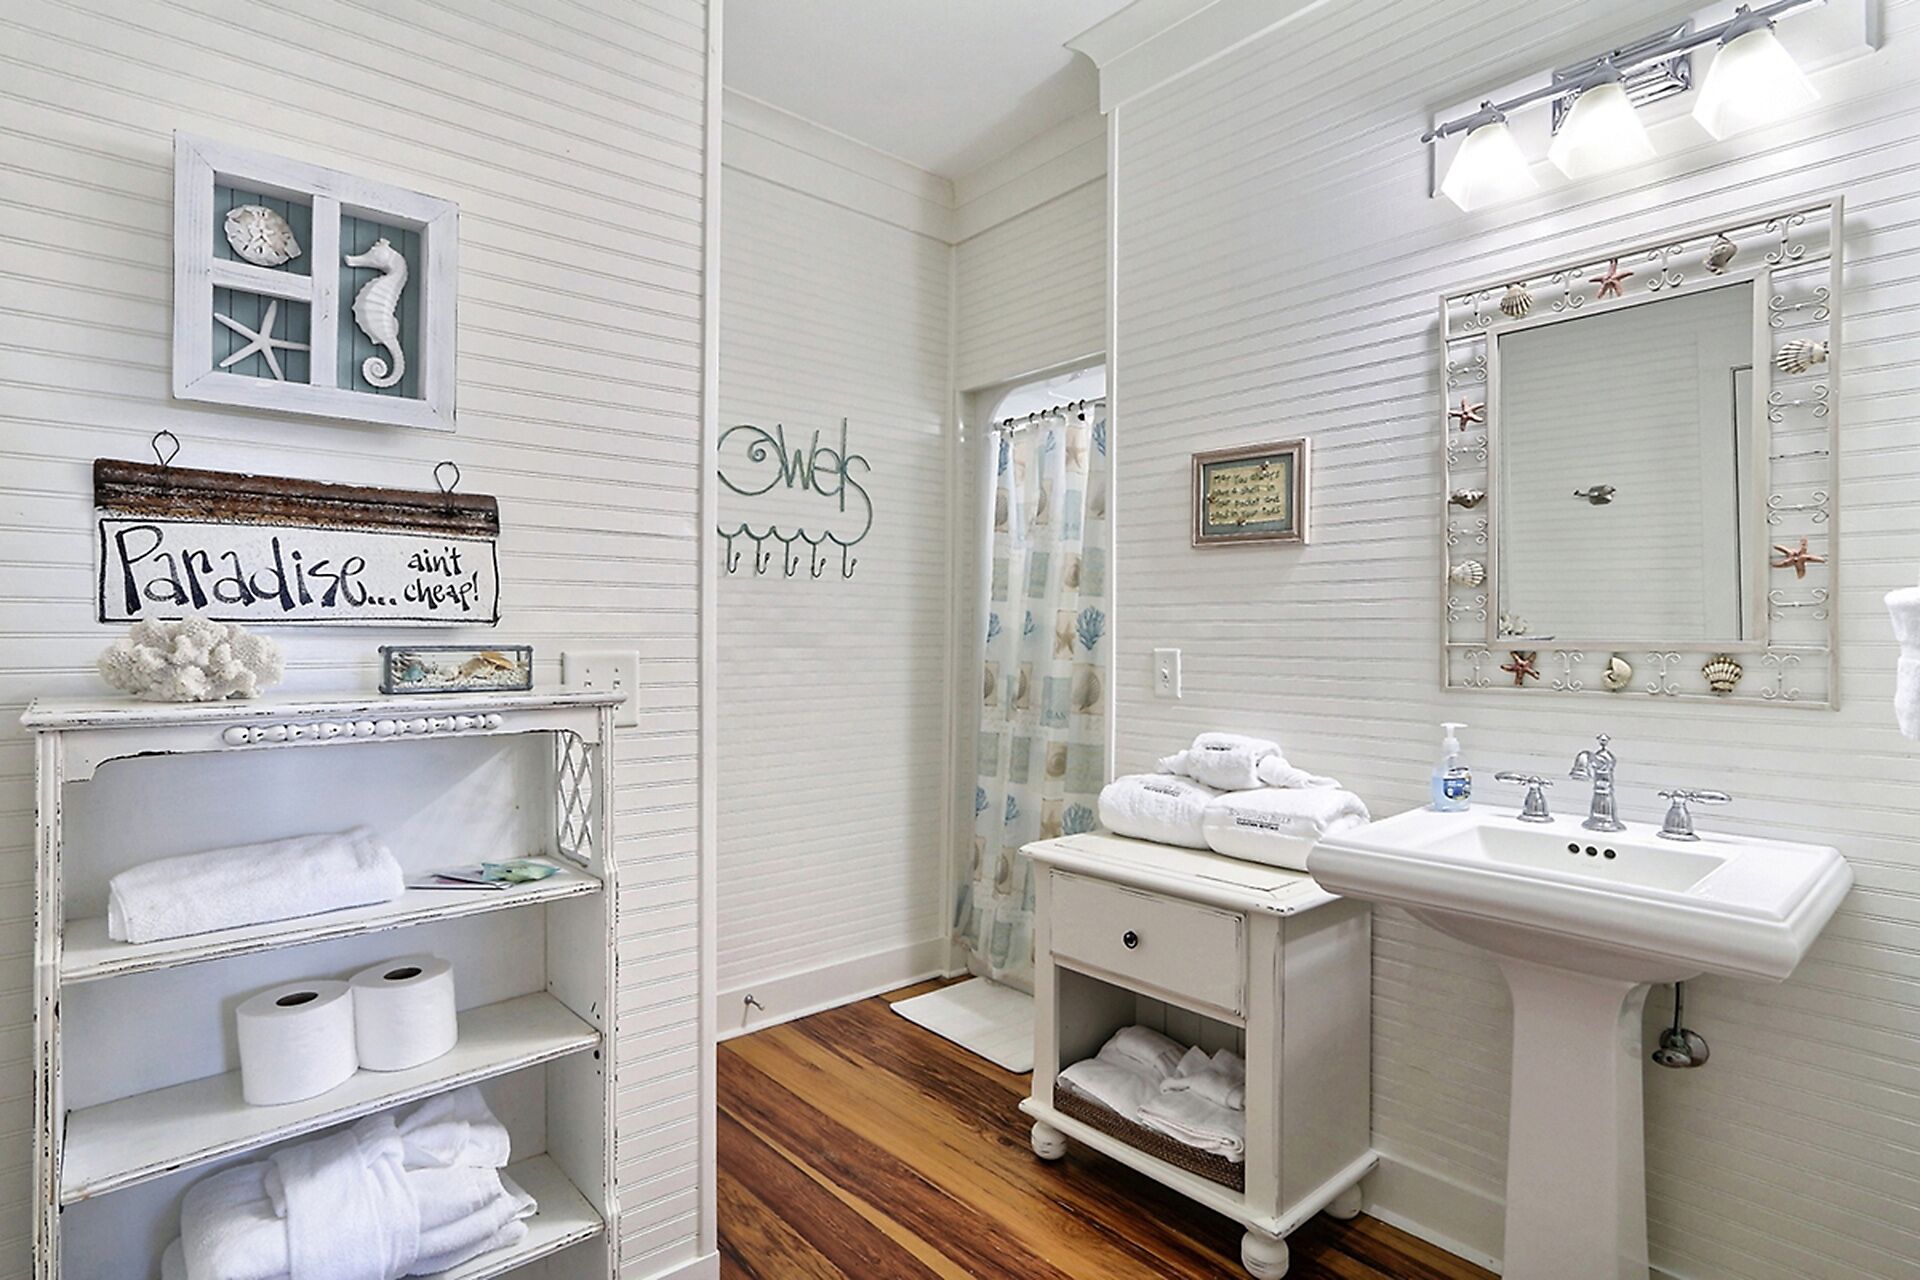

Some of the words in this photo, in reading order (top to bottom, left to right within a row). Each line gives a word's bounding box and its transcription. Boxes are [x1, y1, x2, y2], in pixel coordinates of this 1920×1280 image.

[114, 525, 398, 615] Paradise...
[407, 546, 462, 577] ain't
[404, 571, 479, 611] cheap!
